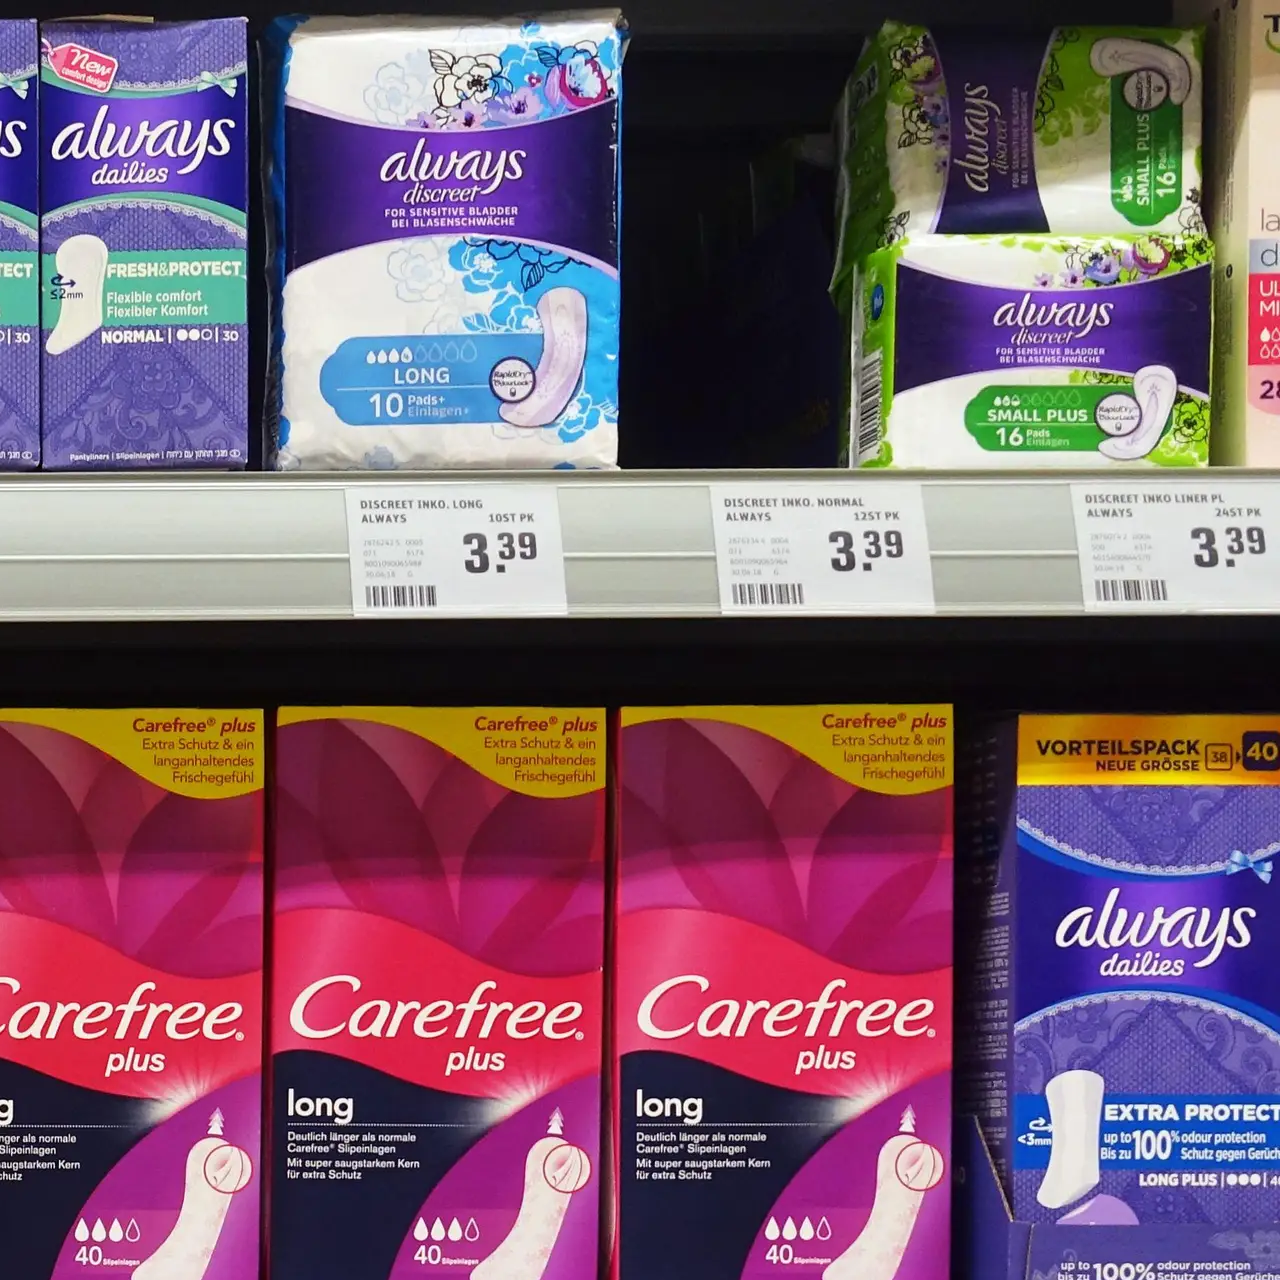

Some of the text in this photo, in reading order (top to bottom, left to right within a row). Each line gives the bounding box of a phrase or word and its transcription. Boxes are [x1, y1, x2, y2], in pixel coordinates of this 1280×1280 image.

[381, 138, 526, 193] always
[403, 183, 481, 205] discreet
[385, 207, 518, 217] FOR SENSITIVE BLADDER
[392, 216, 515, 227] BEI BLASENSCHWÄCHE
[994, 294, 1114, 338] always
[1011, 328, 1074, 346] discreet
[394, 367, 450, 384] LONG
[370, 393, 403, 417] 10
[988, 409, 1087, 422] SMALL PLUS
[996, 428, 1022, 446] 16
[360, 500, 483, 509] DISCREET INKO. LONG
[362, 513, 535, 523] ALWAYS 10ST PK
[463, 532, 537, 573] 3.39
[829, 531, 904, 572] 3.39
[1037, 740, 1201, 758] VORTEILSPACK
[1055, 888, 1256, 969] always
[638, 975, 934, 1039] Carefree
[106, 1048, 166, 1077] plus
[1104, 1105, 1178, 1122] EXTRA
